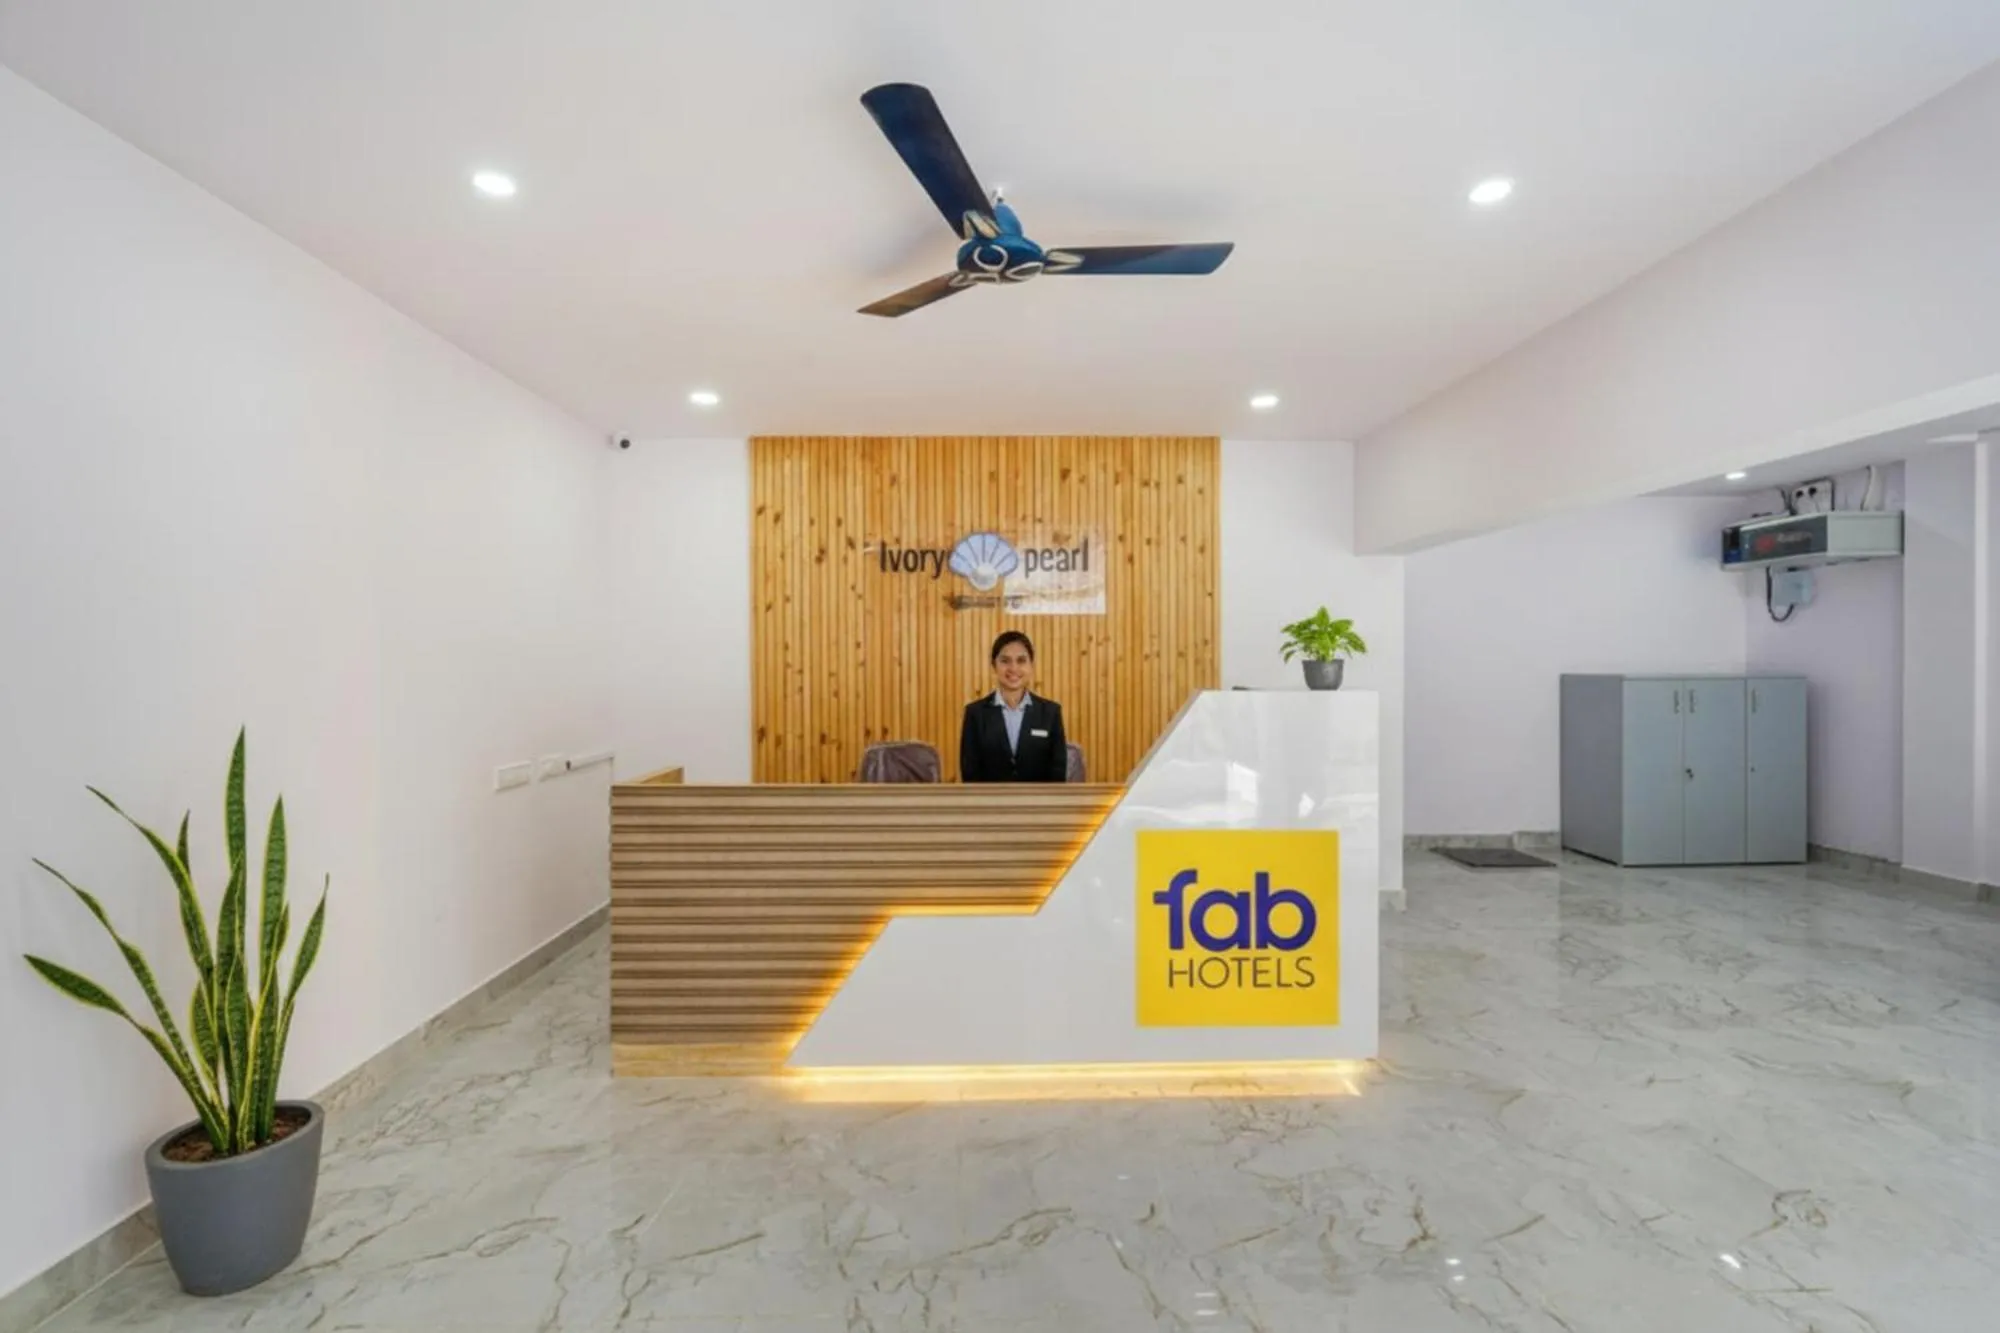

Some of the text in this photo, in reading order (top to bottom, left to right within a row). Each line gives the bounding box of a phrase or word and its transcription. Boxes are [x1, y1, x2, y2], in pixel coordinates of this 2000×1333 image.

[879, 538, 1089, 580] Ivory pearl
[1152, 867, 1317, 953] fab
[1167, 955, 1316, 989] HOTELS
